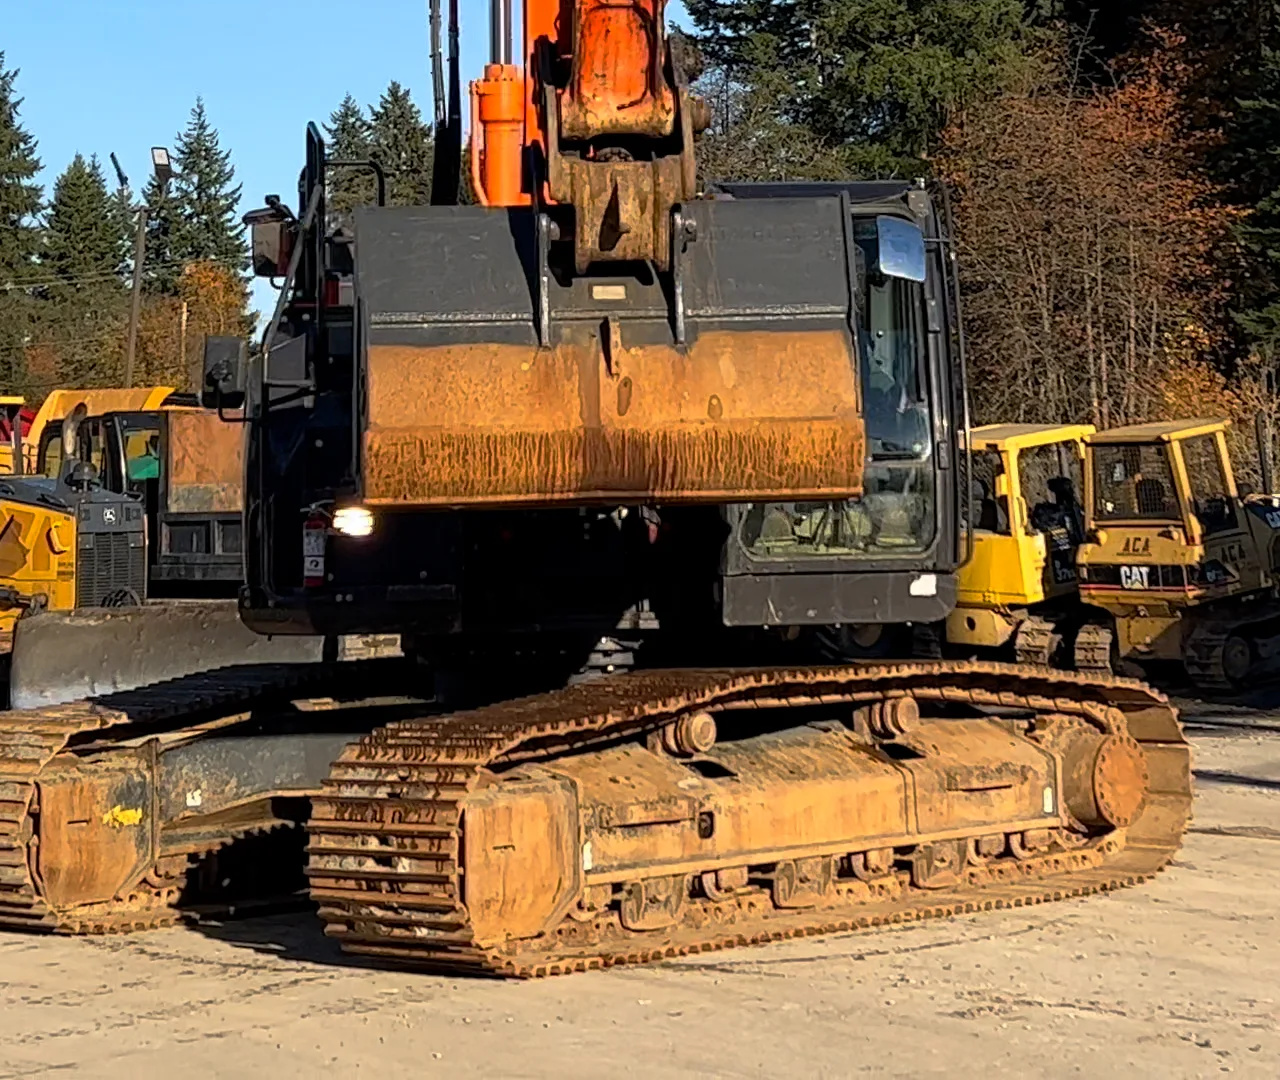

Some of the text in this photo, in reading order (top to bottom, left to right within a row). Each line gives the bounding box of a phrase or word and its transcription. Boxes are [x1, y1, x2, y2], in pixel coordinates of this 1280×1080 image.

[1122, 537, 1150, 552] ACA
[1221, 543, 1246, 563] ACA
[1120, 565, 1150, 590] CAT
